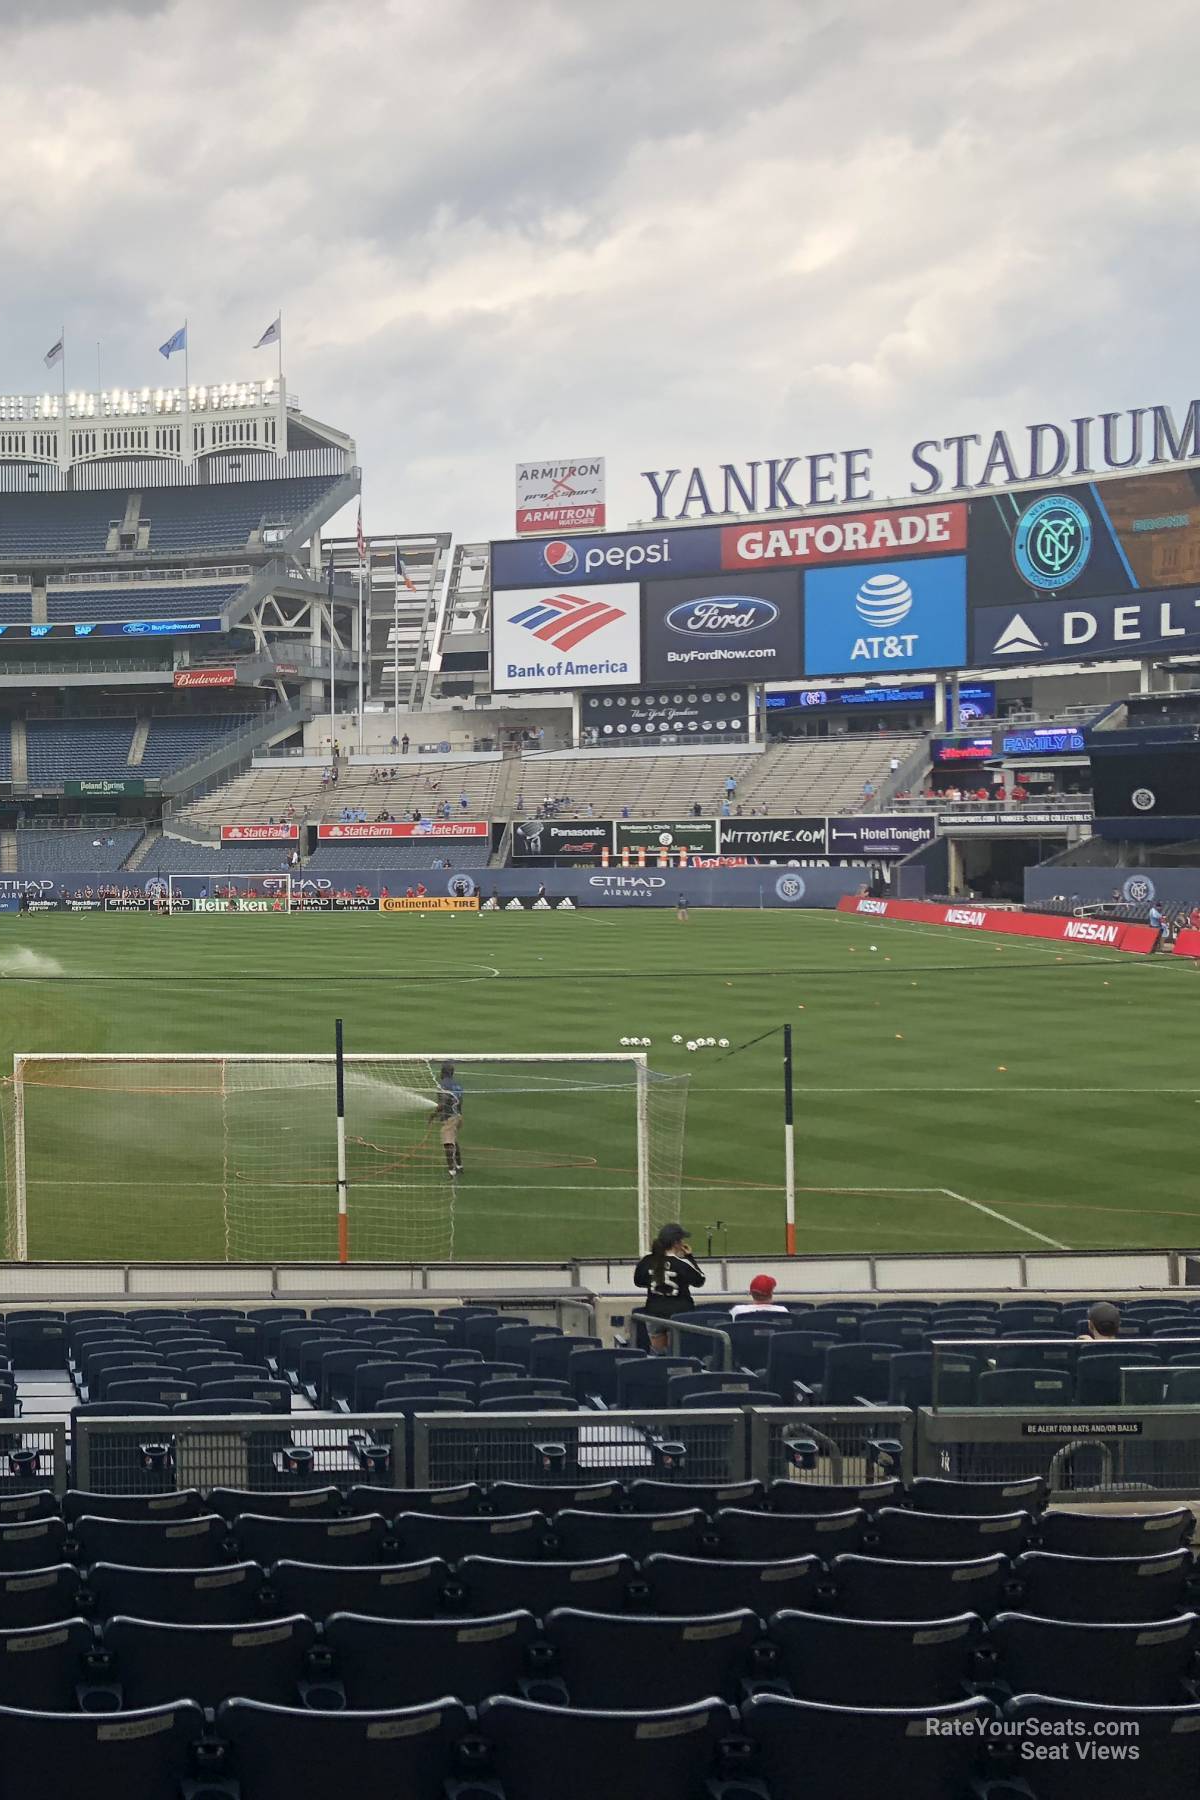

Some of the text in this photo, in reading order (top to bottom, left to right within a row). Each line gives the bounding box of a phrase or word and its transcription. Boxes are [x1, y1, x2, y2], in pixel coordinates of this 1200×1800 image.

[640, 399, 1200, 521] YANKEE STADIUM
[519, 464, 600, 481] ARMITRON
[523, 508, 596, 522] ARMITRON
[558, 517, 595, 526] WATCHES
[736, 512, 951, 560] GATORADE
[585, 538, 670, 573] pepsi
[687, 602, 754, 630] Ford
[1063, 599, 1200, 645] DEL
[31, 626, 49, 637] SAP
[75, 625, 92, 636] SAP
[151, 623, 201, 632] BuyFordNow.com
[851, 635, 919, 660] AT&T
[667, 648, 776, 663] BuyFordNow.com
[507, 660, 628, 678] Bank of America
[176, 672, 234, 686] Budweiser
[1003, 735, 1068, 751] FAMILY
[80, 781, 125, 791] Poland Spring
[551, 827, 606, 837] Panasonic
[721, 829, 826, 844] NITTOTIRE.COM
[589, 876, 666, 887] ETIHAD
[603, 889, 652, 897] AIRWAYS
[383, 898, 476, 910] Continental TIRE
[856, 900, 888, 915] NISSAN
[945, 909, 986, 926] NISSAN
[1064, 921, 1118, 943] NISSAN
[1118, 1424, 1138, 1432] BALLS
